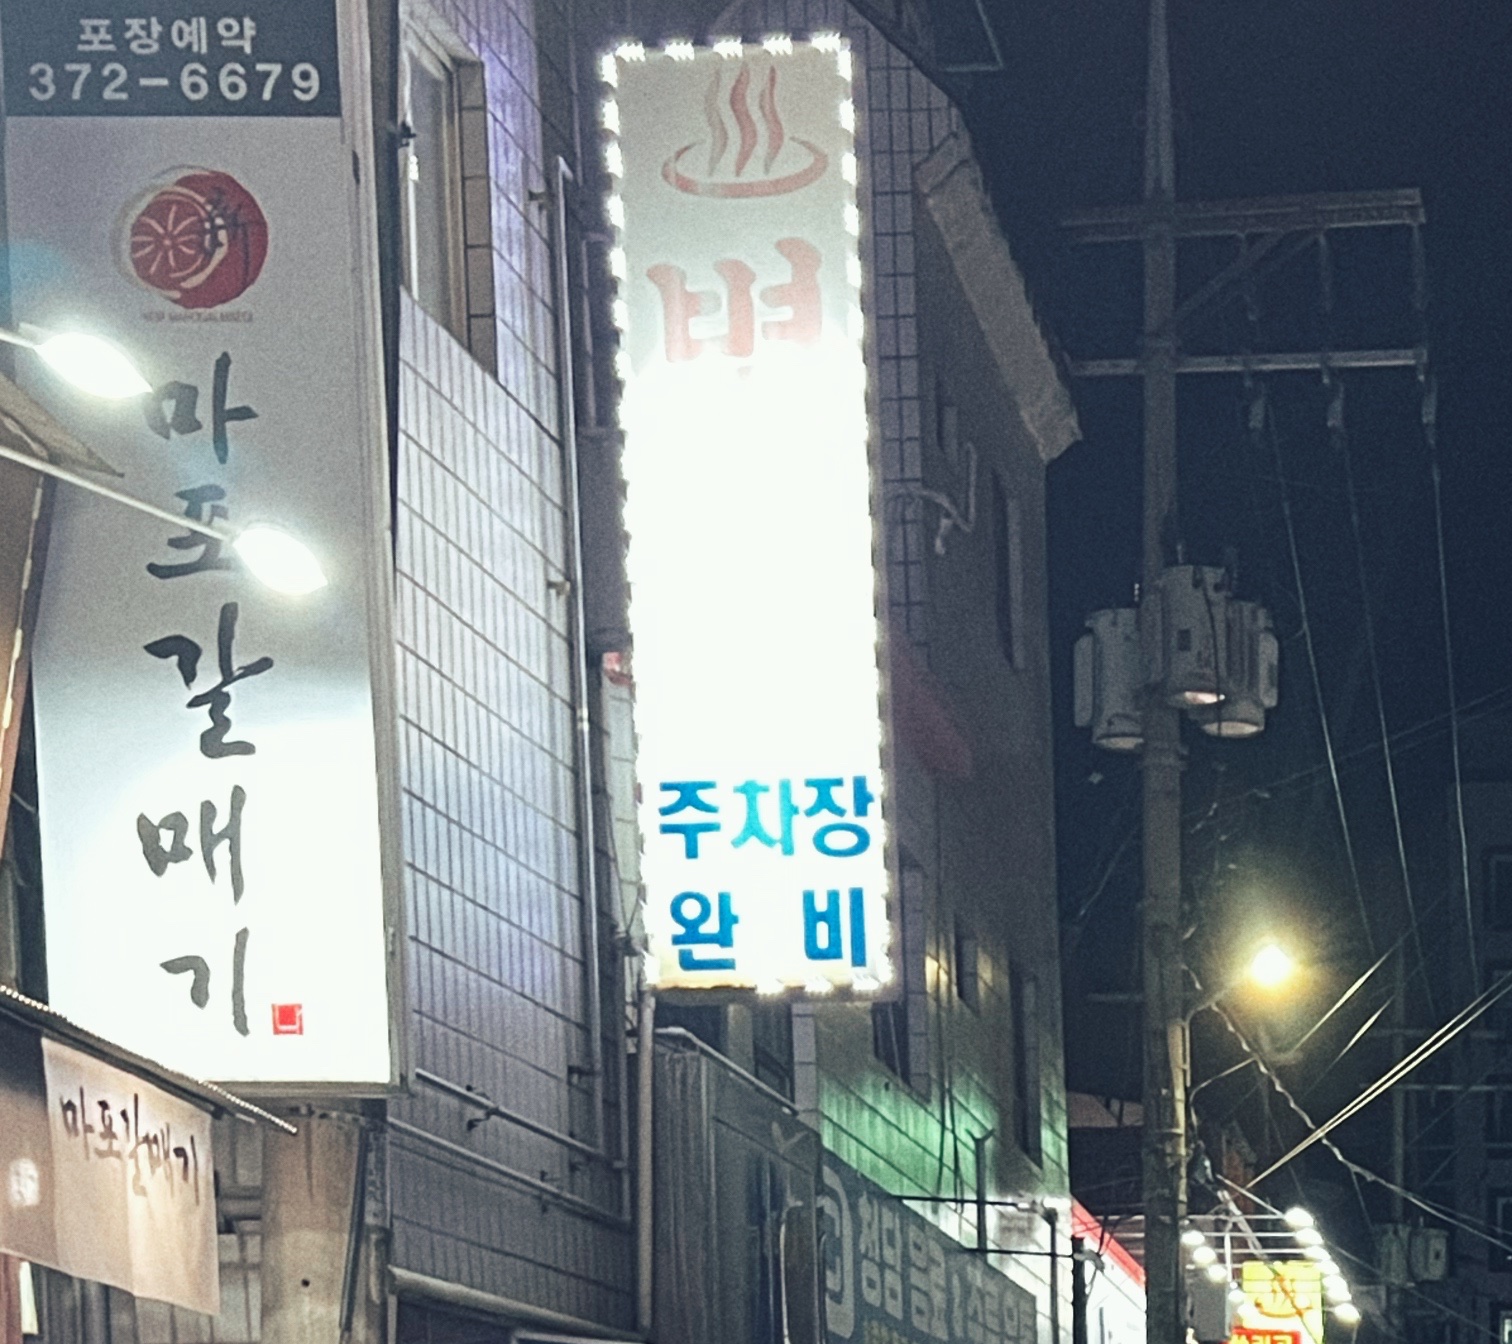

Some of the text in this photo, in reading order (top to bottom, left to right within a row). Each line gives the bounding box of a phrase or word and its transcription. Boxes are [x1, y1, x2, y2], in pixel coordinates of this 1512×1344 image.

[77, 16, 257, 54] 포장예약
[29, 63, 321, 101] 372-6679
[137, 351, 274, 1037] 마포갈매기
[658, 776, 874, 859] 주차장
